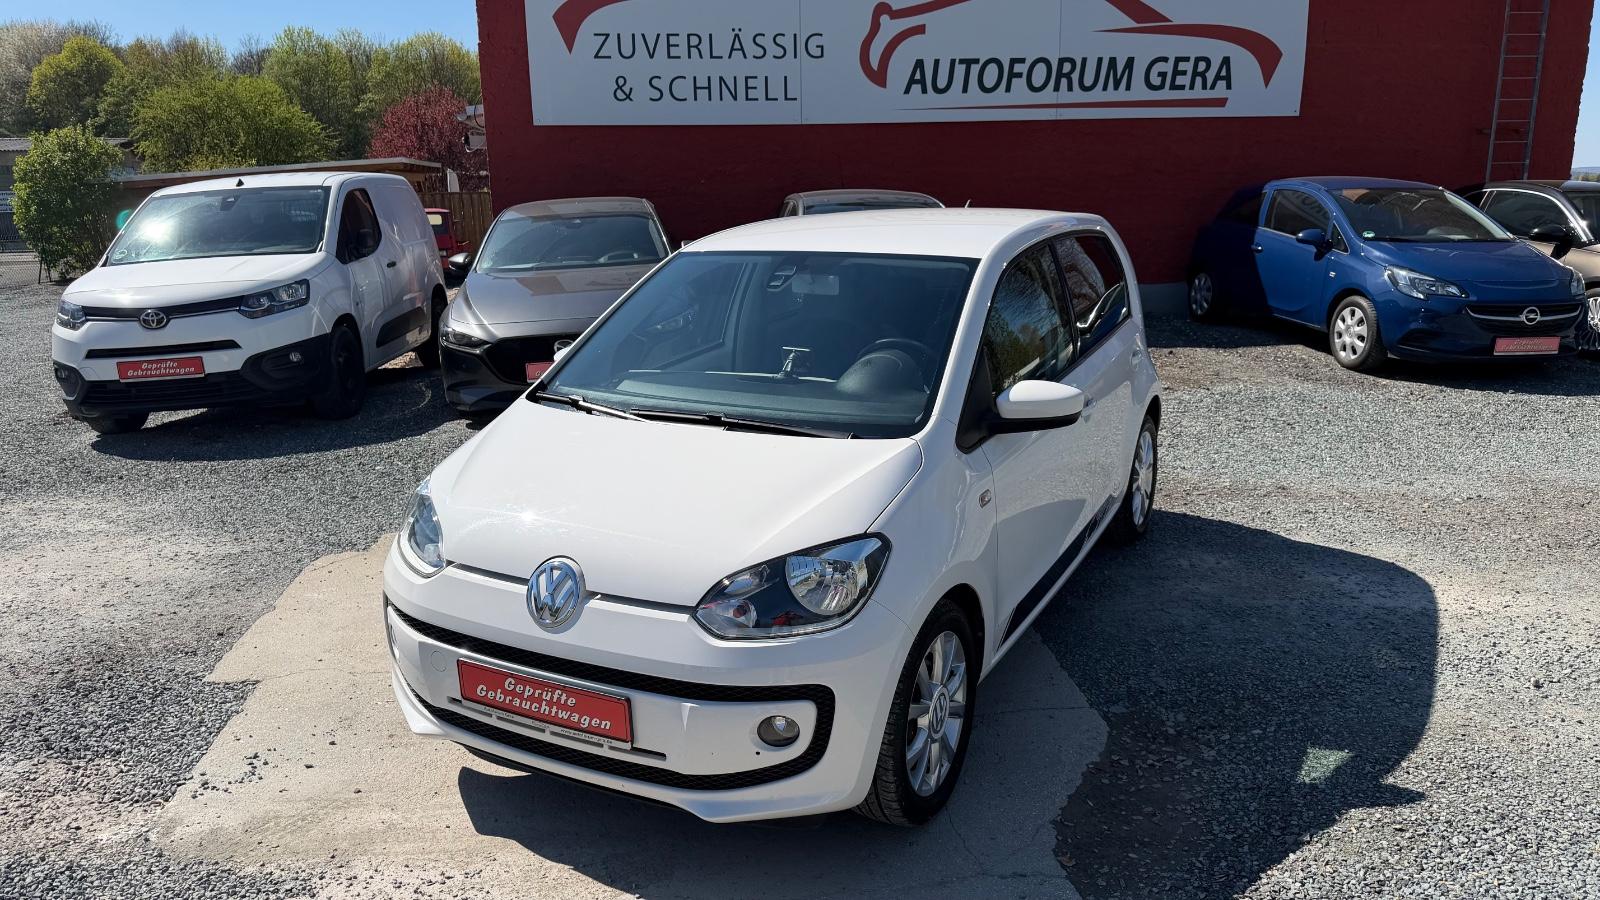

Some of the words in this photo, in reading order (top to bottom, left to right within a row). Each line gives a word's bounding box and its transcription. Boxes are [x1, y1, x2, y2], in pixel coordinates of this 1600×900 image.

[593, 27, 825, 60] ZUVERLÄSSIG
[612, 75, 634, 102] &
[648, 75, 798, 102] SCHNELL
[903, 56, 1136, 94] AUTOFORUM
[1143, 55, 1233, 91] GERA
[476, 684, 612, 731] Gebrauchtwagen
[504, 677, 577, 707] Geprüfte
